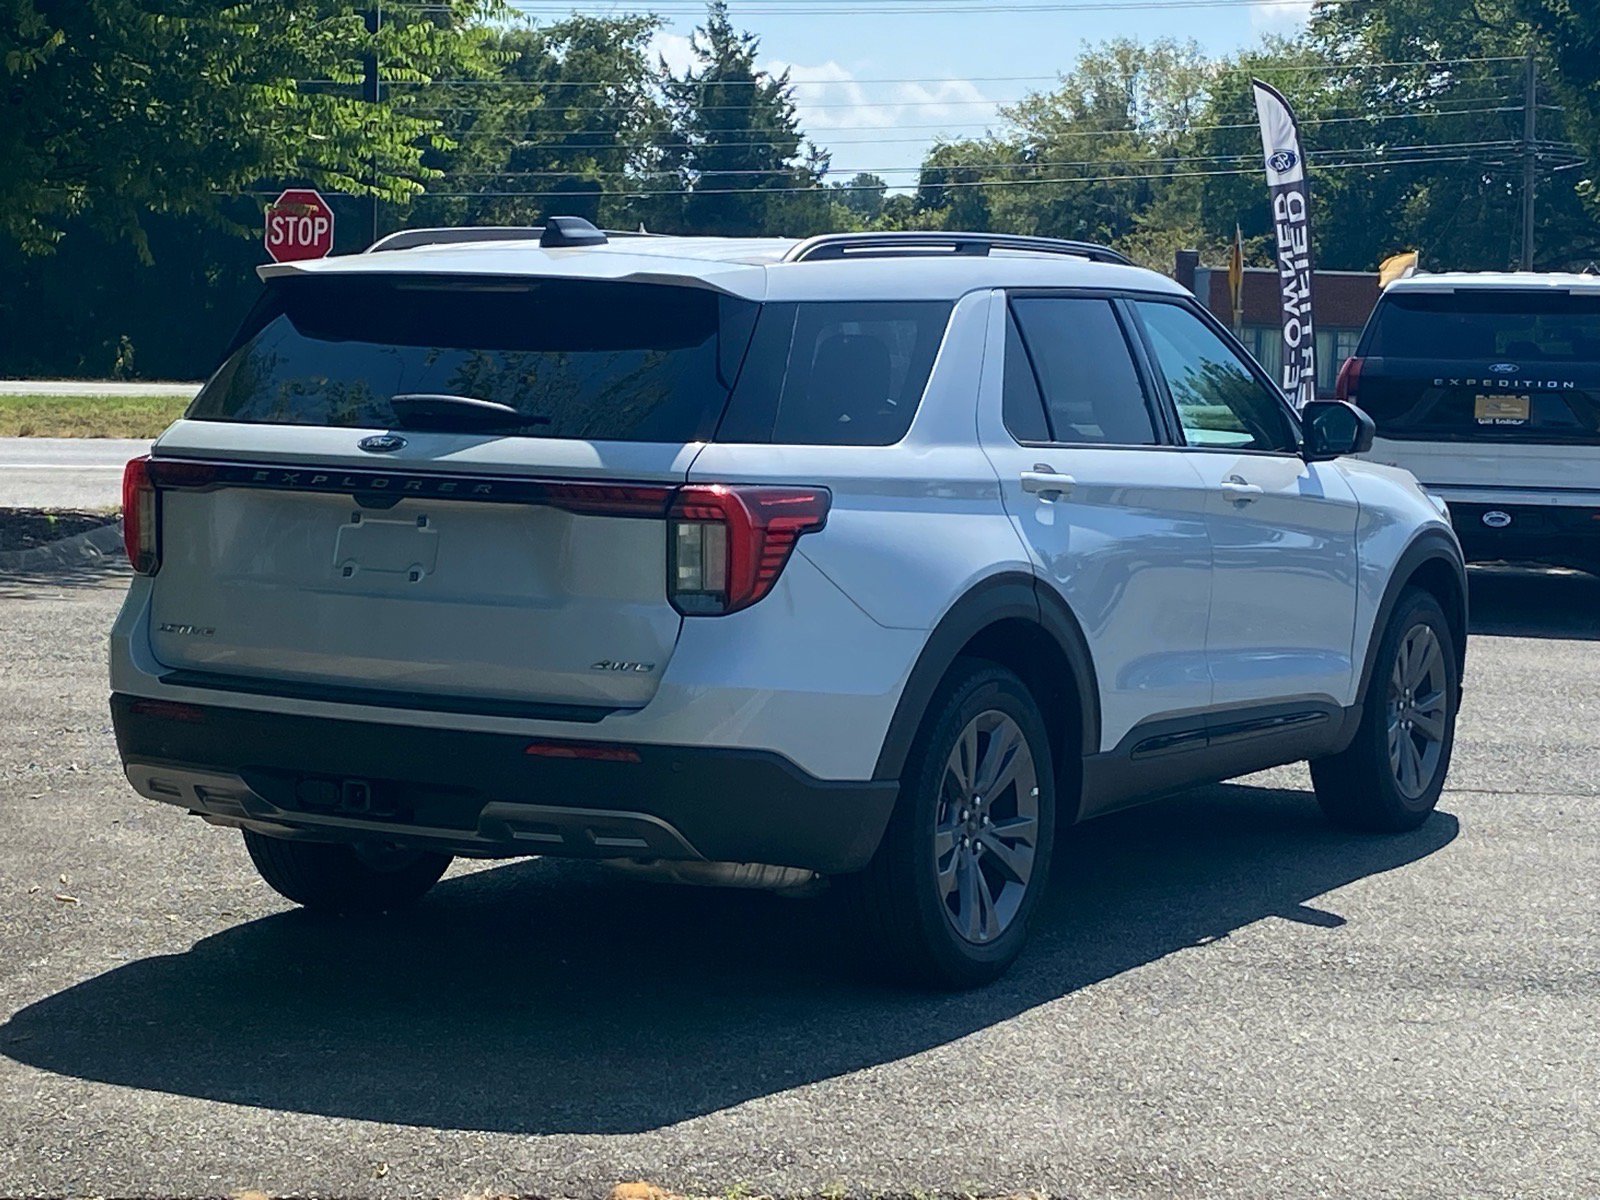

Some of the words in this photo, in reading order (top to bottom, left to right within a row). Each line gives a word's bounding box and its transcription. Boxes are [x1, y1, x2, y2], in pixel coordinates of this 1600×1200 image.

[271, 216, 328, 246] STOP
[1434, 379, 1574, 388] EXPEDITION
[363, 436, 399, 448] Ford
[252, 471, 492, 494] EXPLORER
